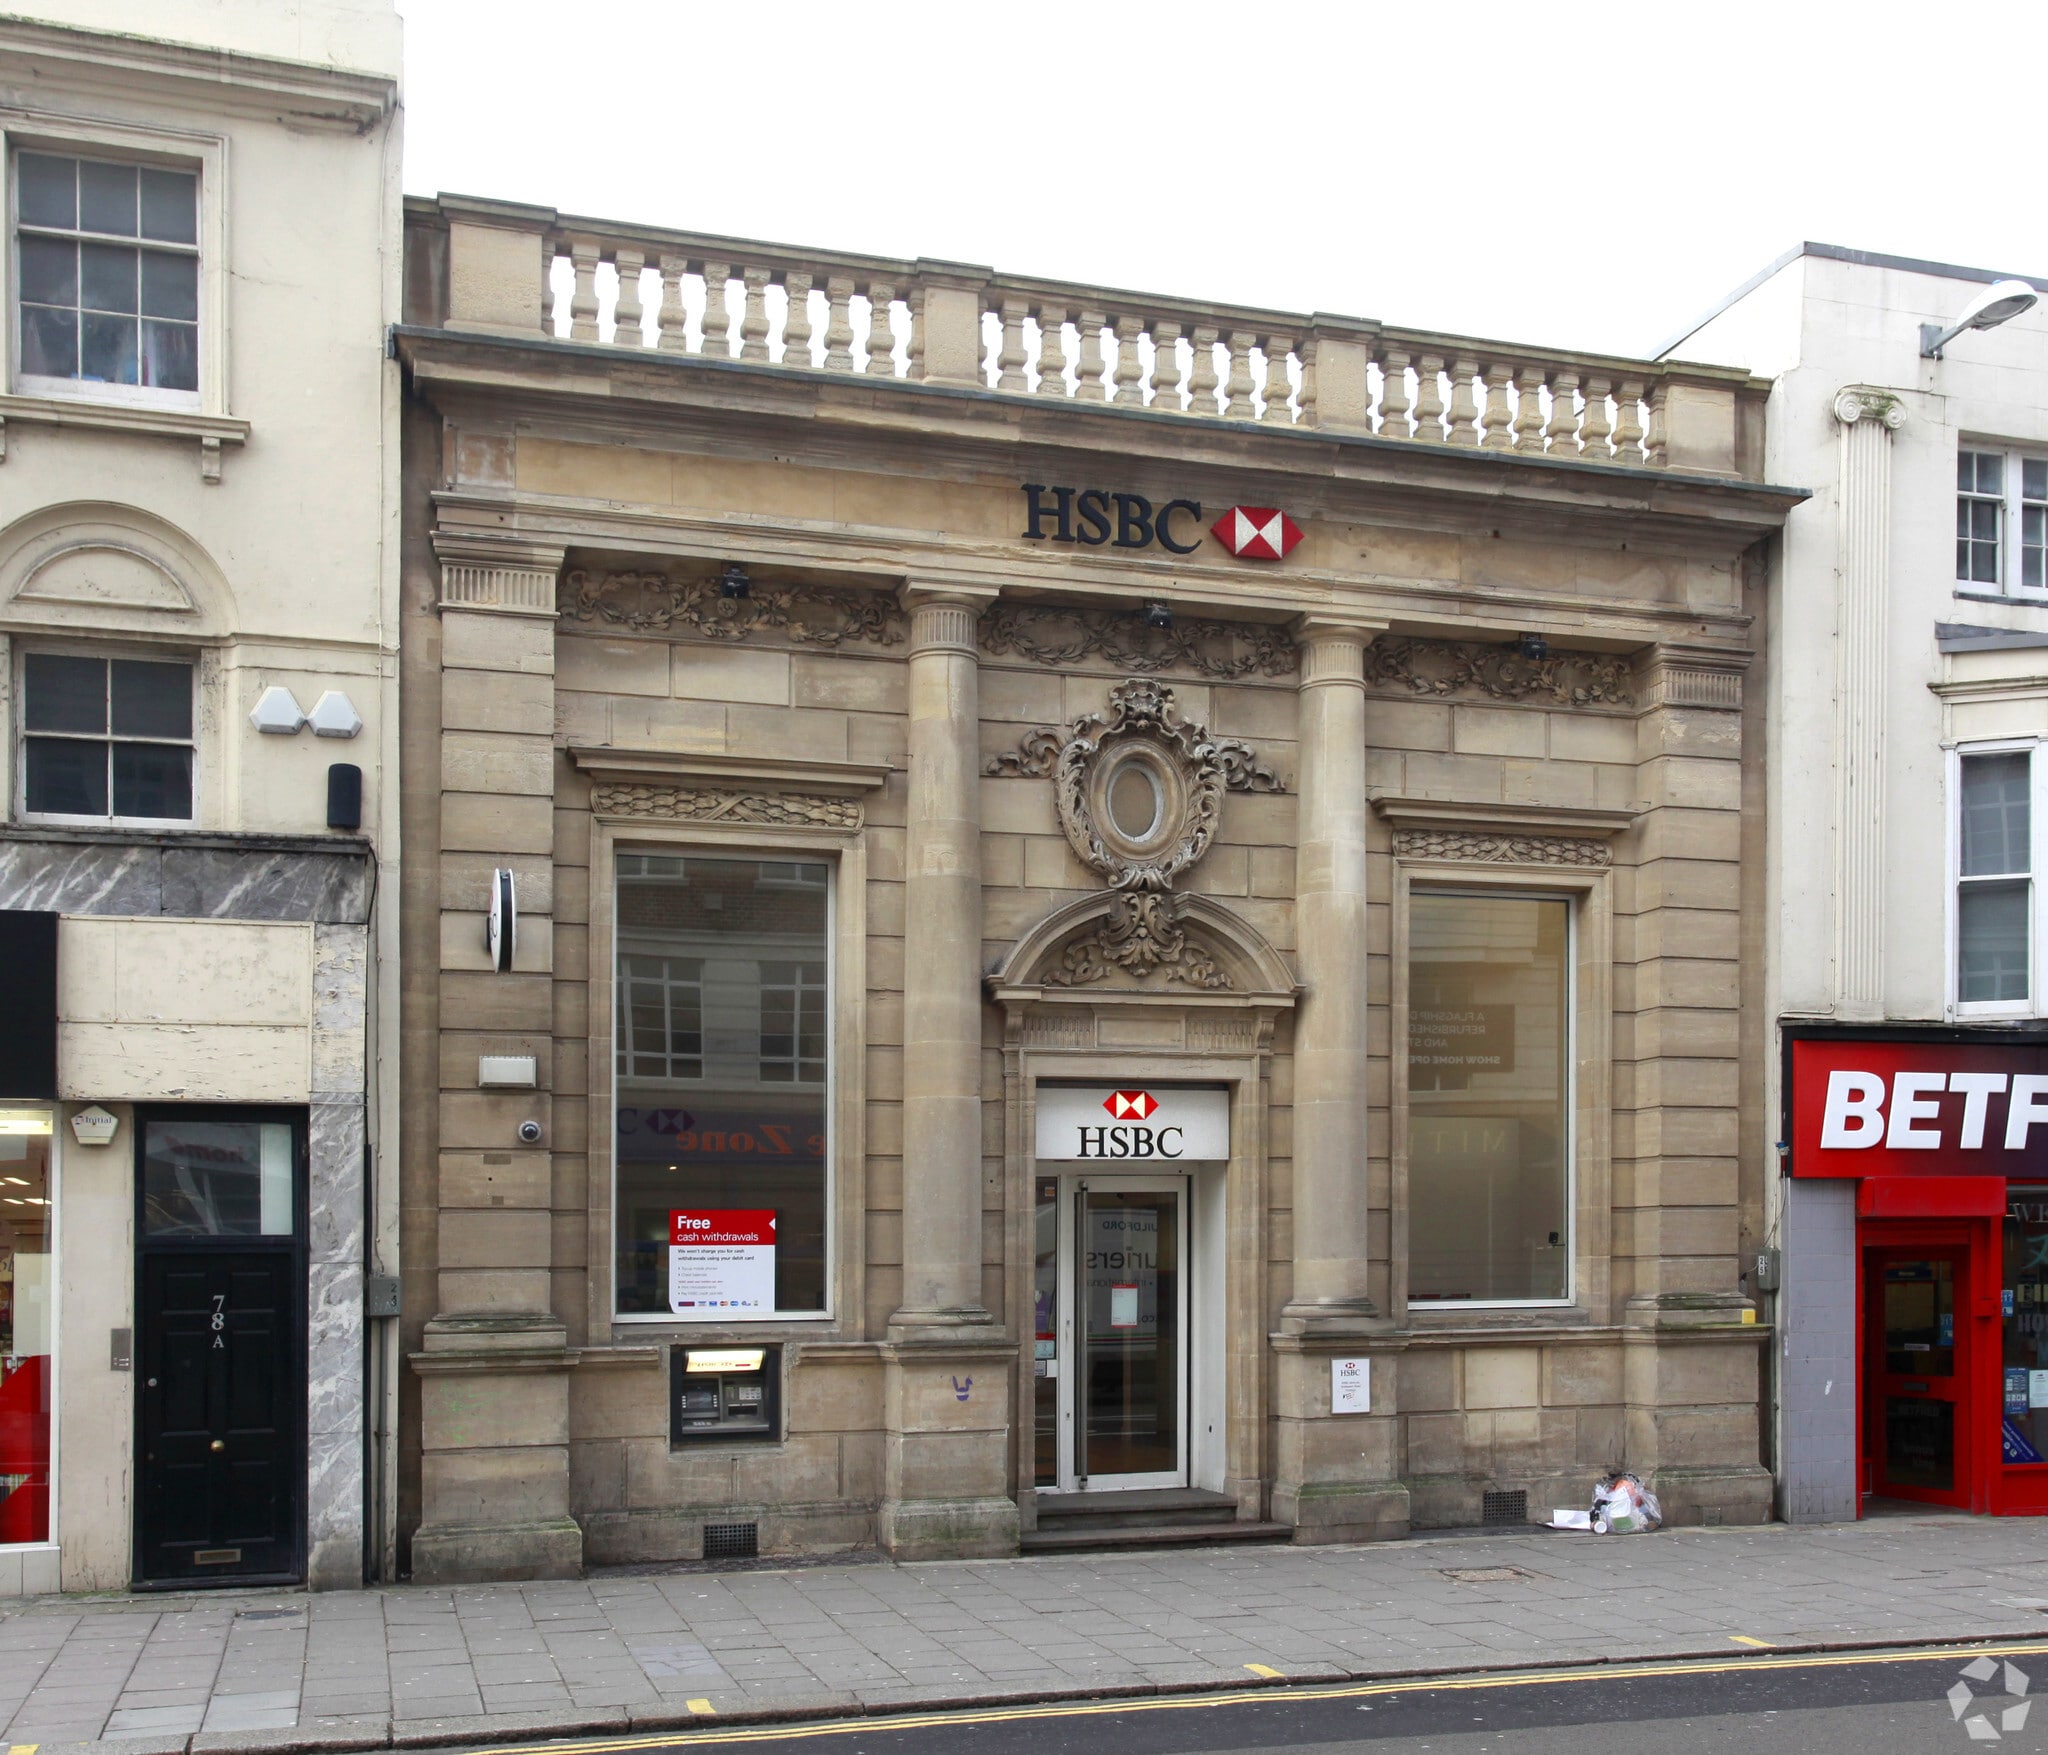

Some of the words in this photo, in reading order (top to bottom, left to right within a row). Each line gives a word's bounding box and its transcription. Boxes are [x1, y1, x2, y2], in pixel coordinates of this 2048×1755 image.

[1021, 483, 1202, 555] HSBC
[1820, 1070, 2048, 1150] BETF
[85, 1116, 112, 1124] Initial
[1076, 1127, 1184, 1159] HSBC
[677, 1216, 711, 1230] Free
[677, 1232, 699, 1242] cash
[701, 1231, 759, 1242] withdrawals
[1340, 1369, 1361, 1377] HSBC
